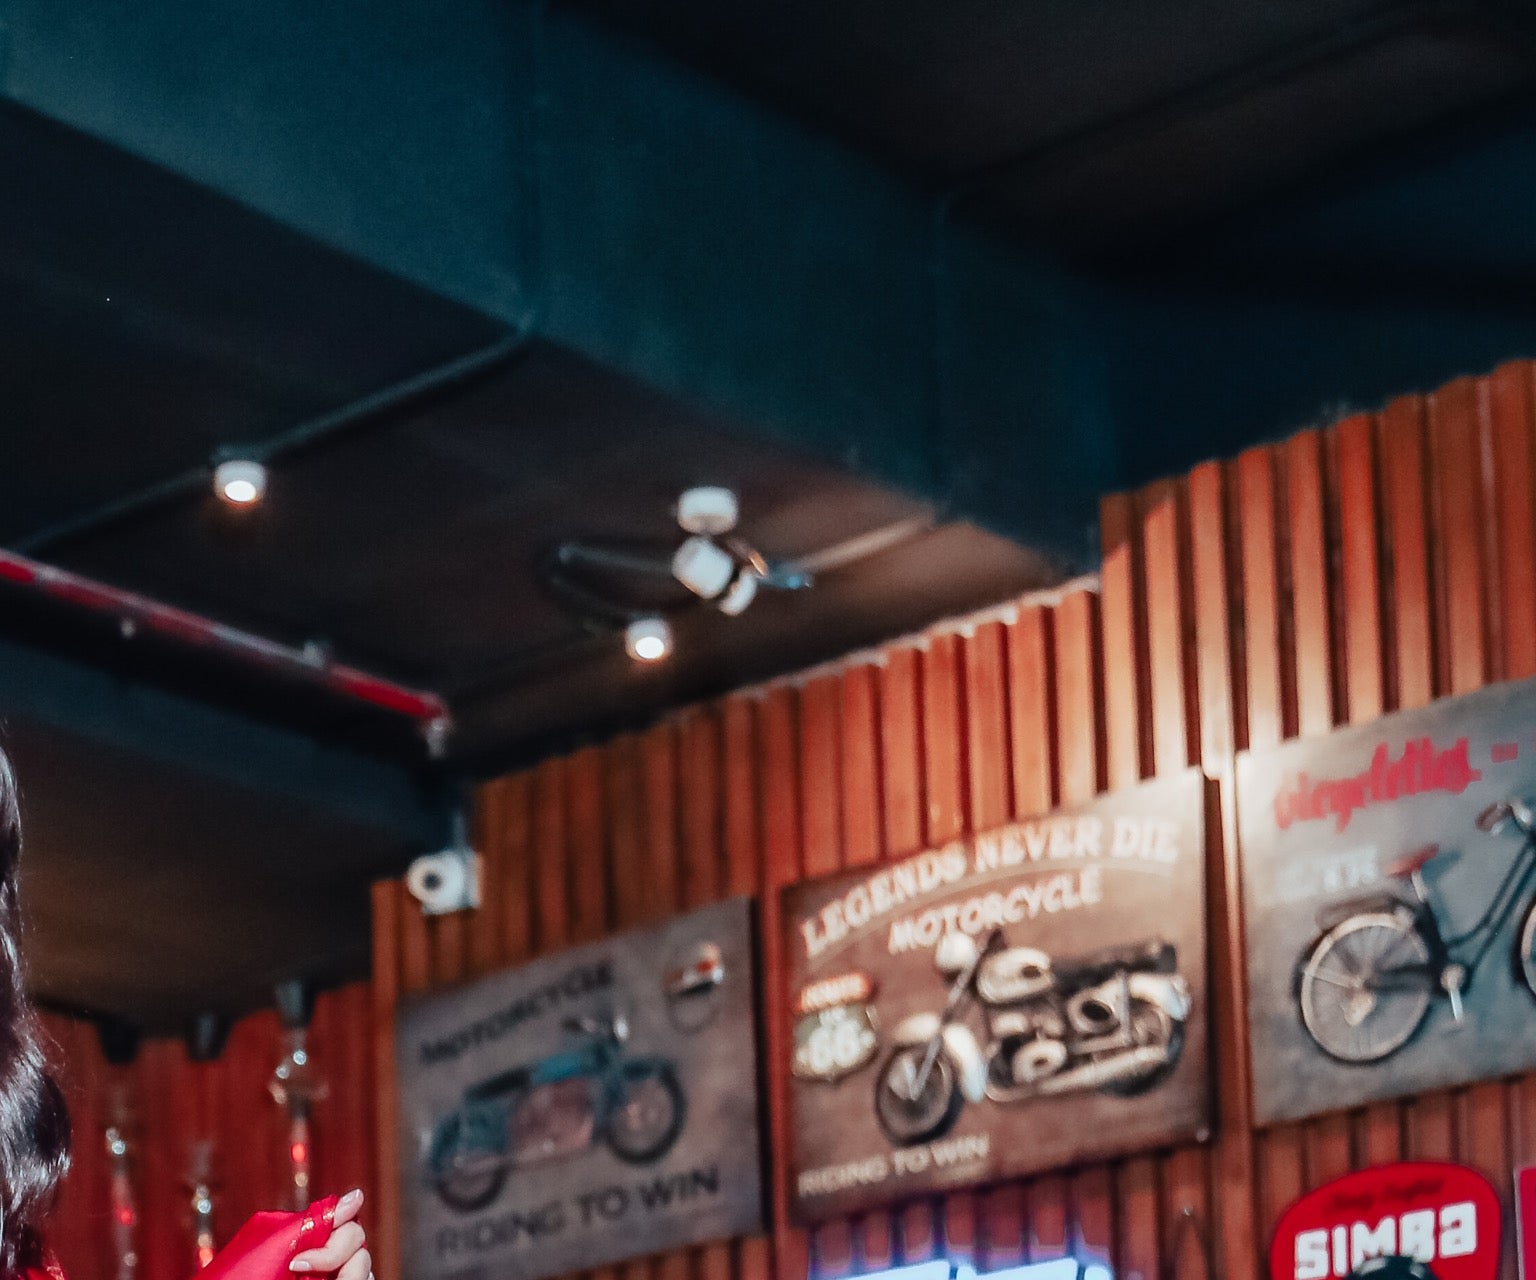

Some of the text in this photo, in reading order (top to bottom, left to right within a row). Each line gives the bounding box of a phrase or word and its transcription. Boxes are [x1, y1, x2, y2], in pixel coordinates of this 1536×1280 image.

[800, 816, 1179, 958] LEGENDS NEVER DIE
[887, 863, 1105, 956] MOTORCYCLE
[575, 1186, 629, 1225] TO
[638, 1162, 719, 1212] WIN
[894, 1148, 930, 1177] TO
[931, 1132, 990, 1167] WIN
